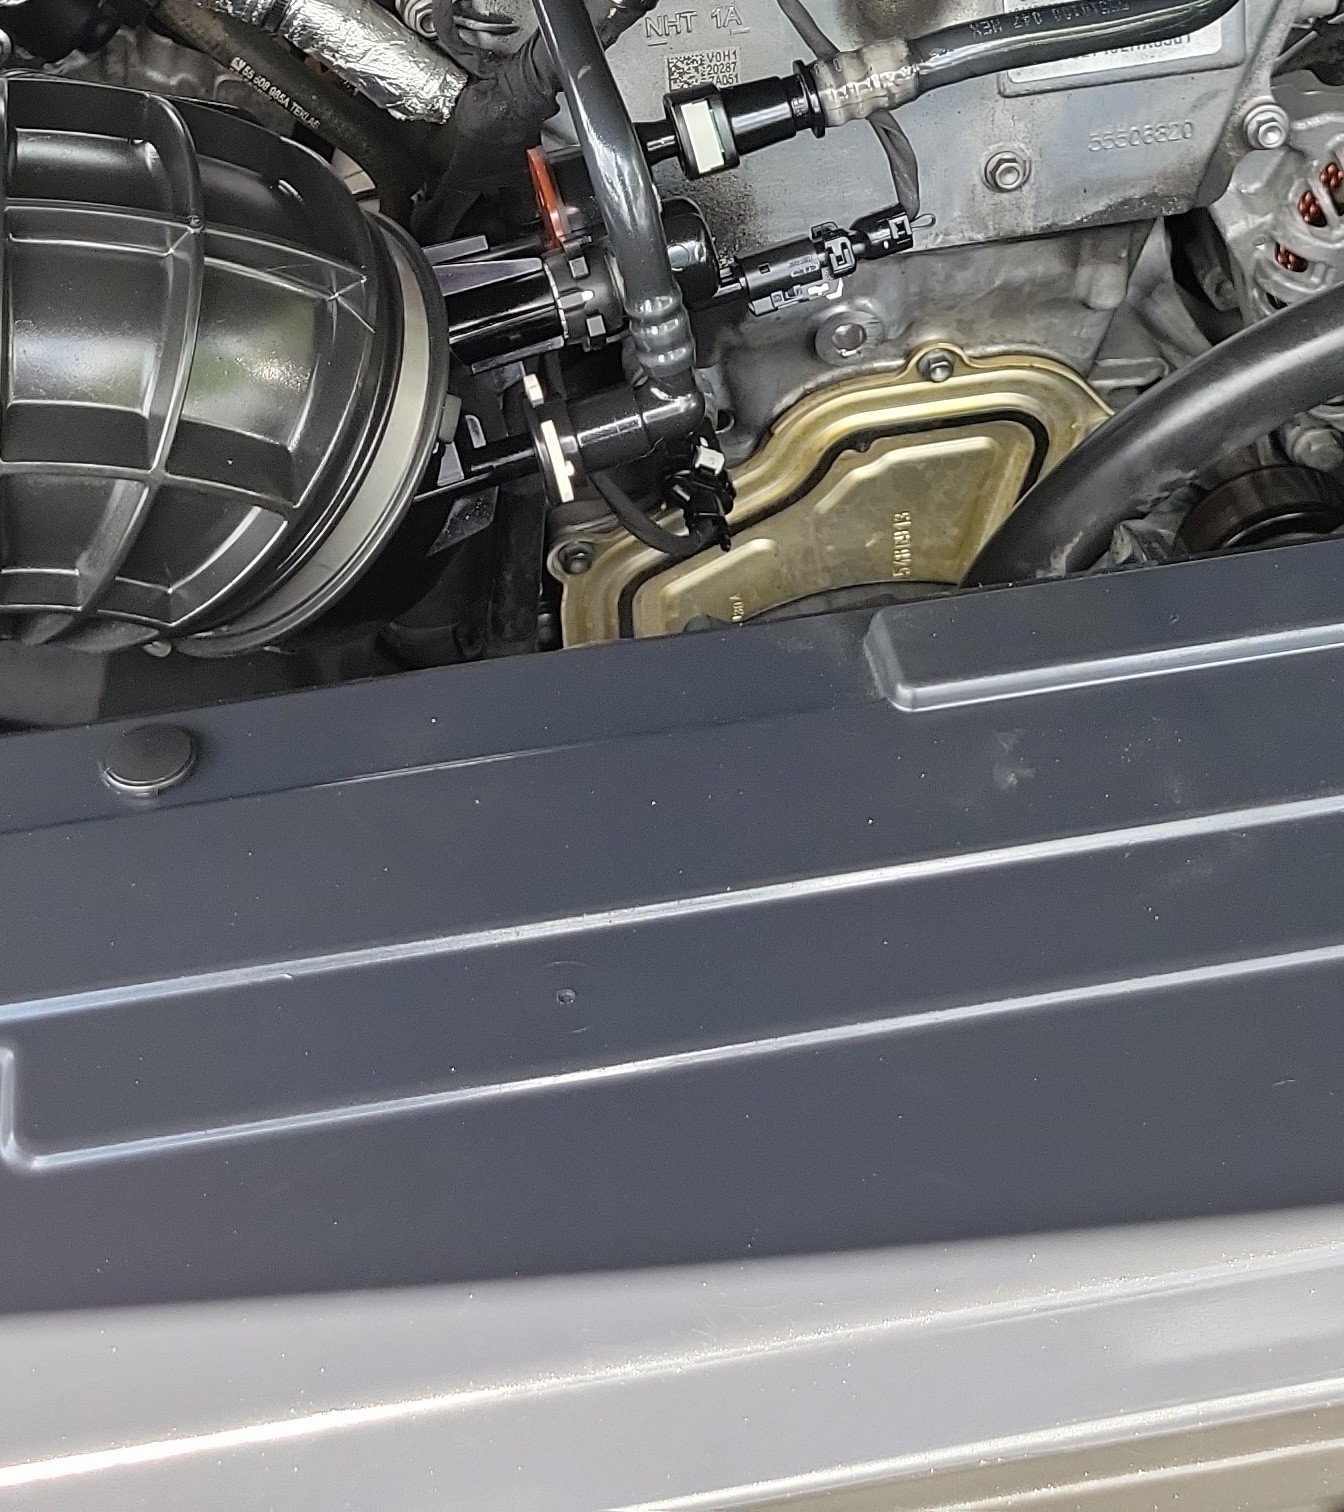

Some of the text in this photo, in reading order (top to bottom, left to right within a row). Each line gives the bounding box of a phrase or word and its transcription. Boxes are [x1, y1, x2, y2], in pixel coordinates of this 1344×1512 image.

[645, 5, 743, 39] NHT 1A
[706, 61, 737, 75] 20287
